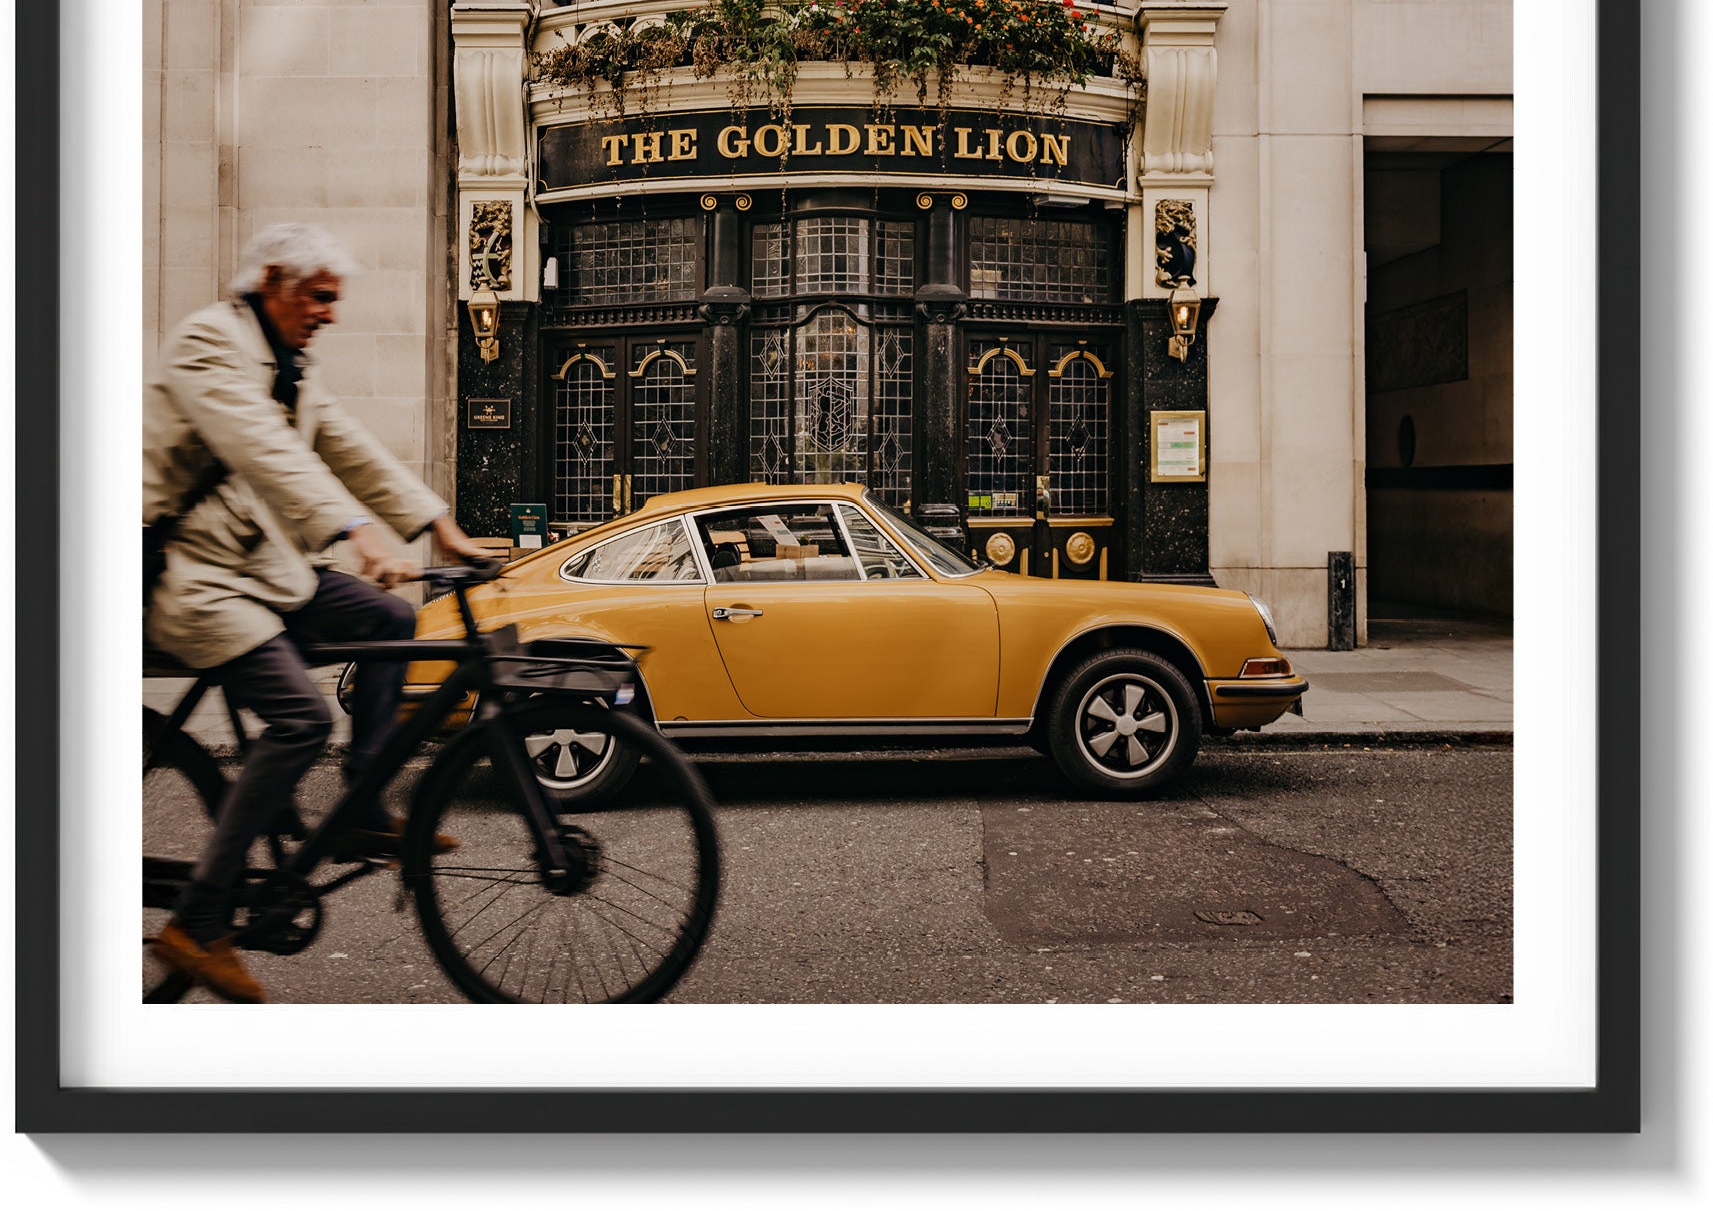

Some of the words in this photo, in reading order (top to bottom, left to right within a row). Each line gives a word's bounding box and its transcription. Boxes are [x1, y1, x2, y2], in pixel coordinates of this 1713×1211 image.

[601, 128, 698, 167] THE
[717, 123, 938, 158] GOLDEN
[954, 126, 1072, 167] LION
[1340, 578, 1346, 589] 1
